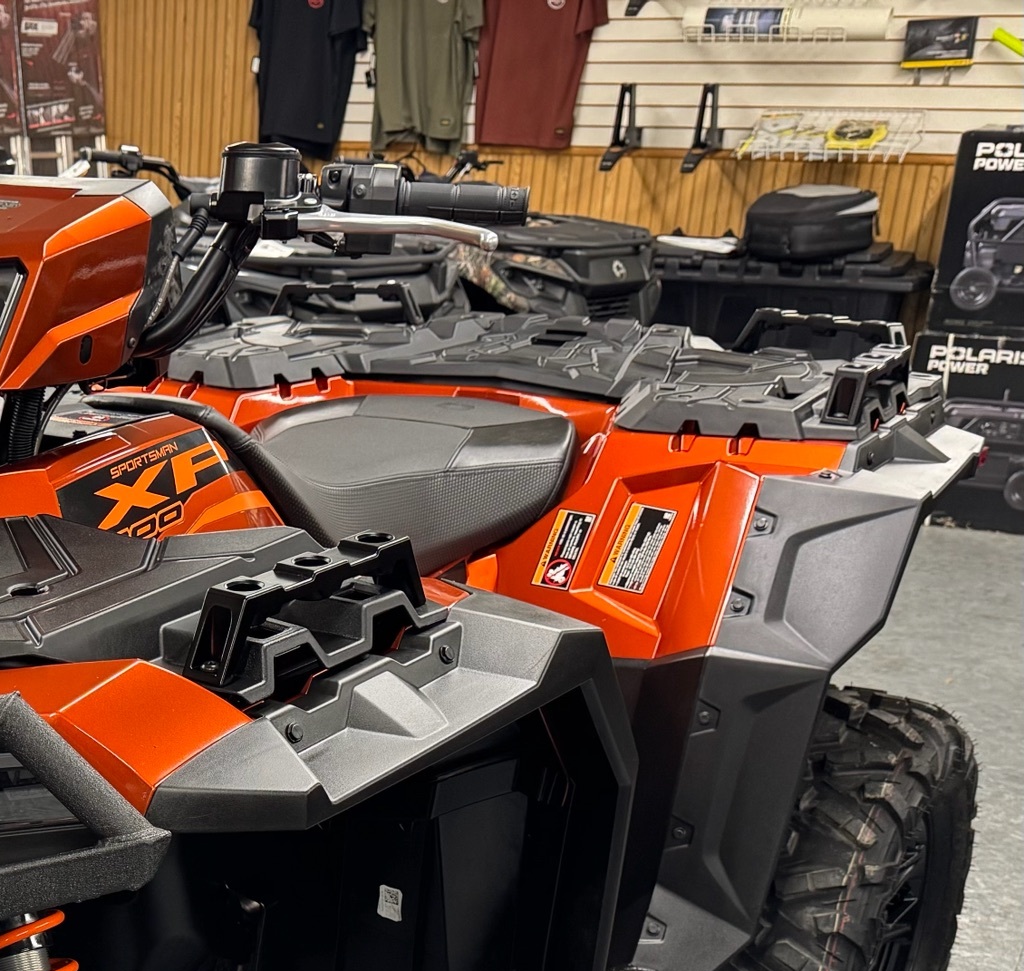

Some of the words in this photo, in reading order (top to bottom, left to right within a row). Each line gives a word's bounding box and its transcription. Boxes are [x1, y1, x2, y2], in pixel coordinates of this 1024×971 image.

[927, 359, 990, 375] POWER
[110, 441, 179, 479] SPORTSMAN
[94, 440, 229, 530] XP
[543, 528, 559, 561] WARNING
[614, 524, 631, 558] WARNING
